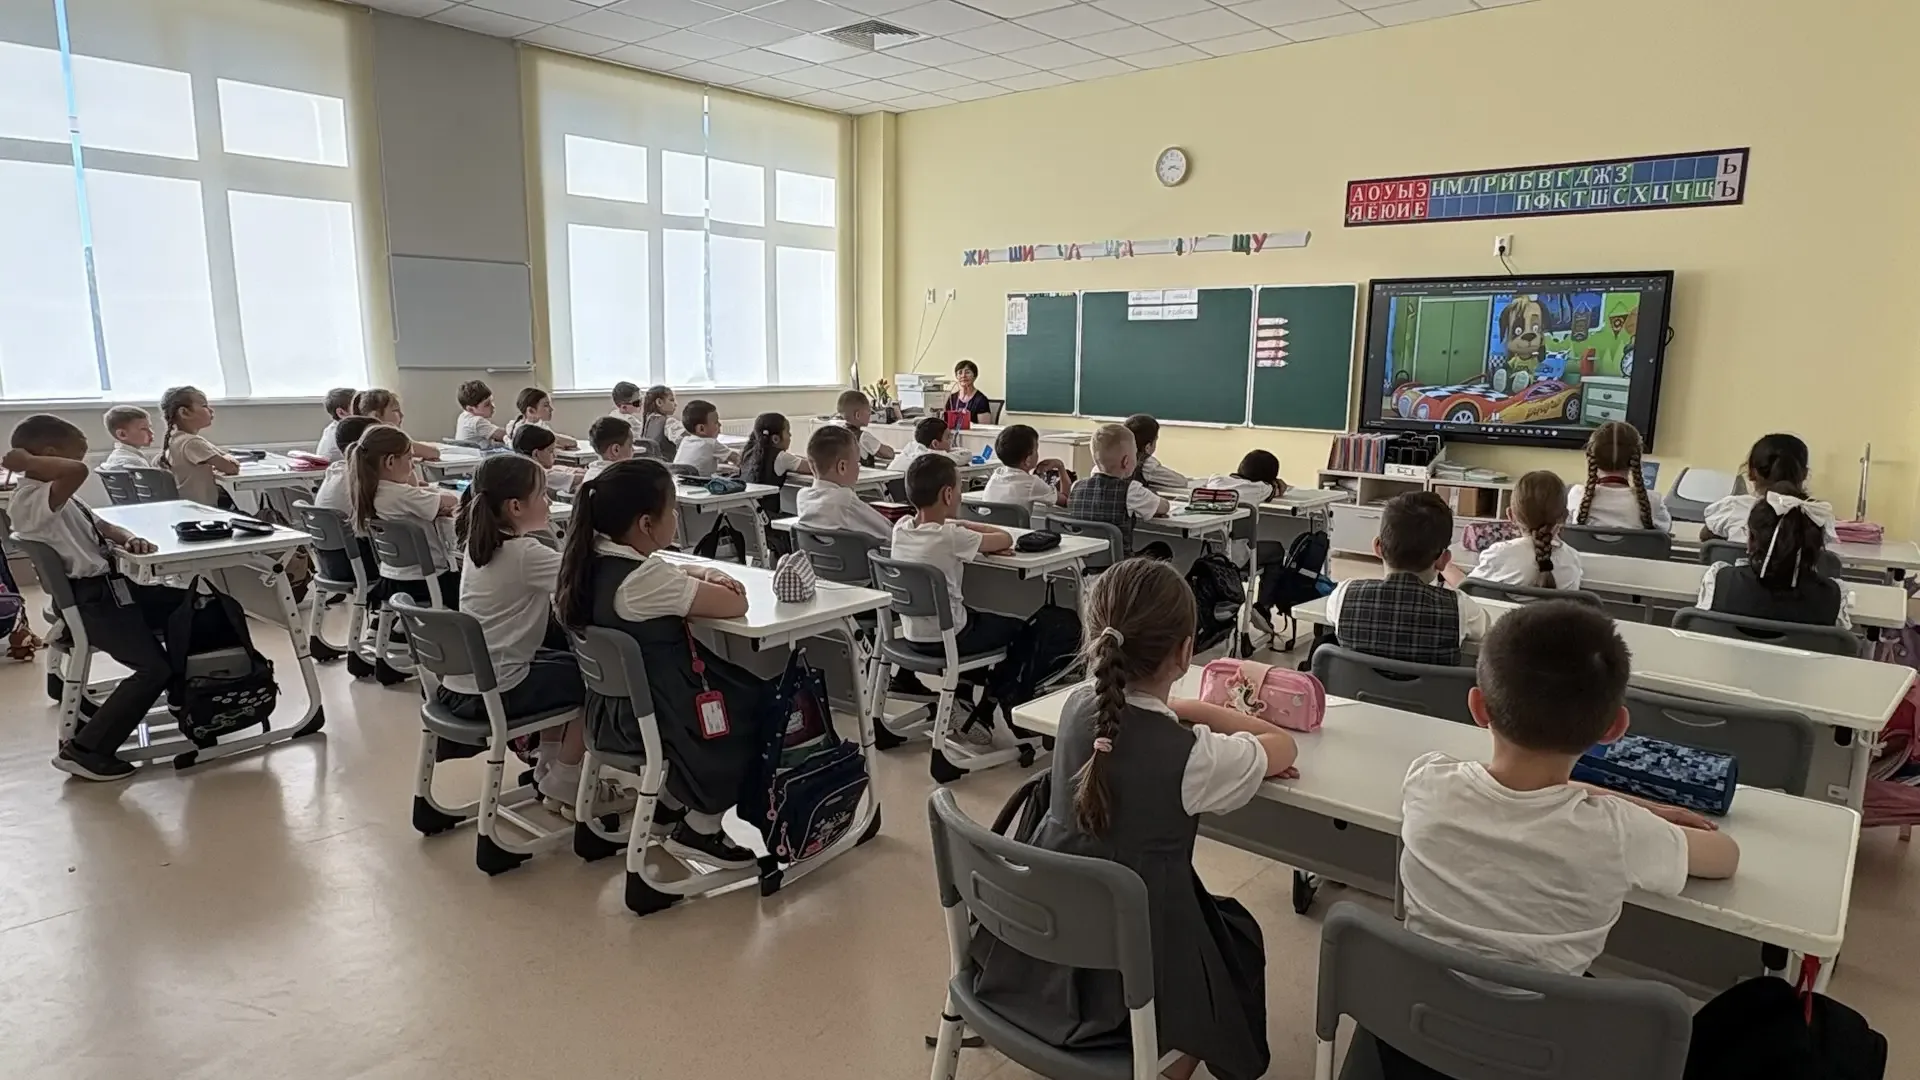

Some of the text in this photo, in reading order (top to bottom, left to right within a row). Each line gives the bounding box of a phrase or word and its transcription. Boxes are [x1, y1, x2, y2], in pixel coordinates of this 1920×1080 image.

[963, 249, 990, 266] ЖИ
[1008, 245, 1035, 262] ШИ
[1232, 233, 1268, 256] ЩУ
